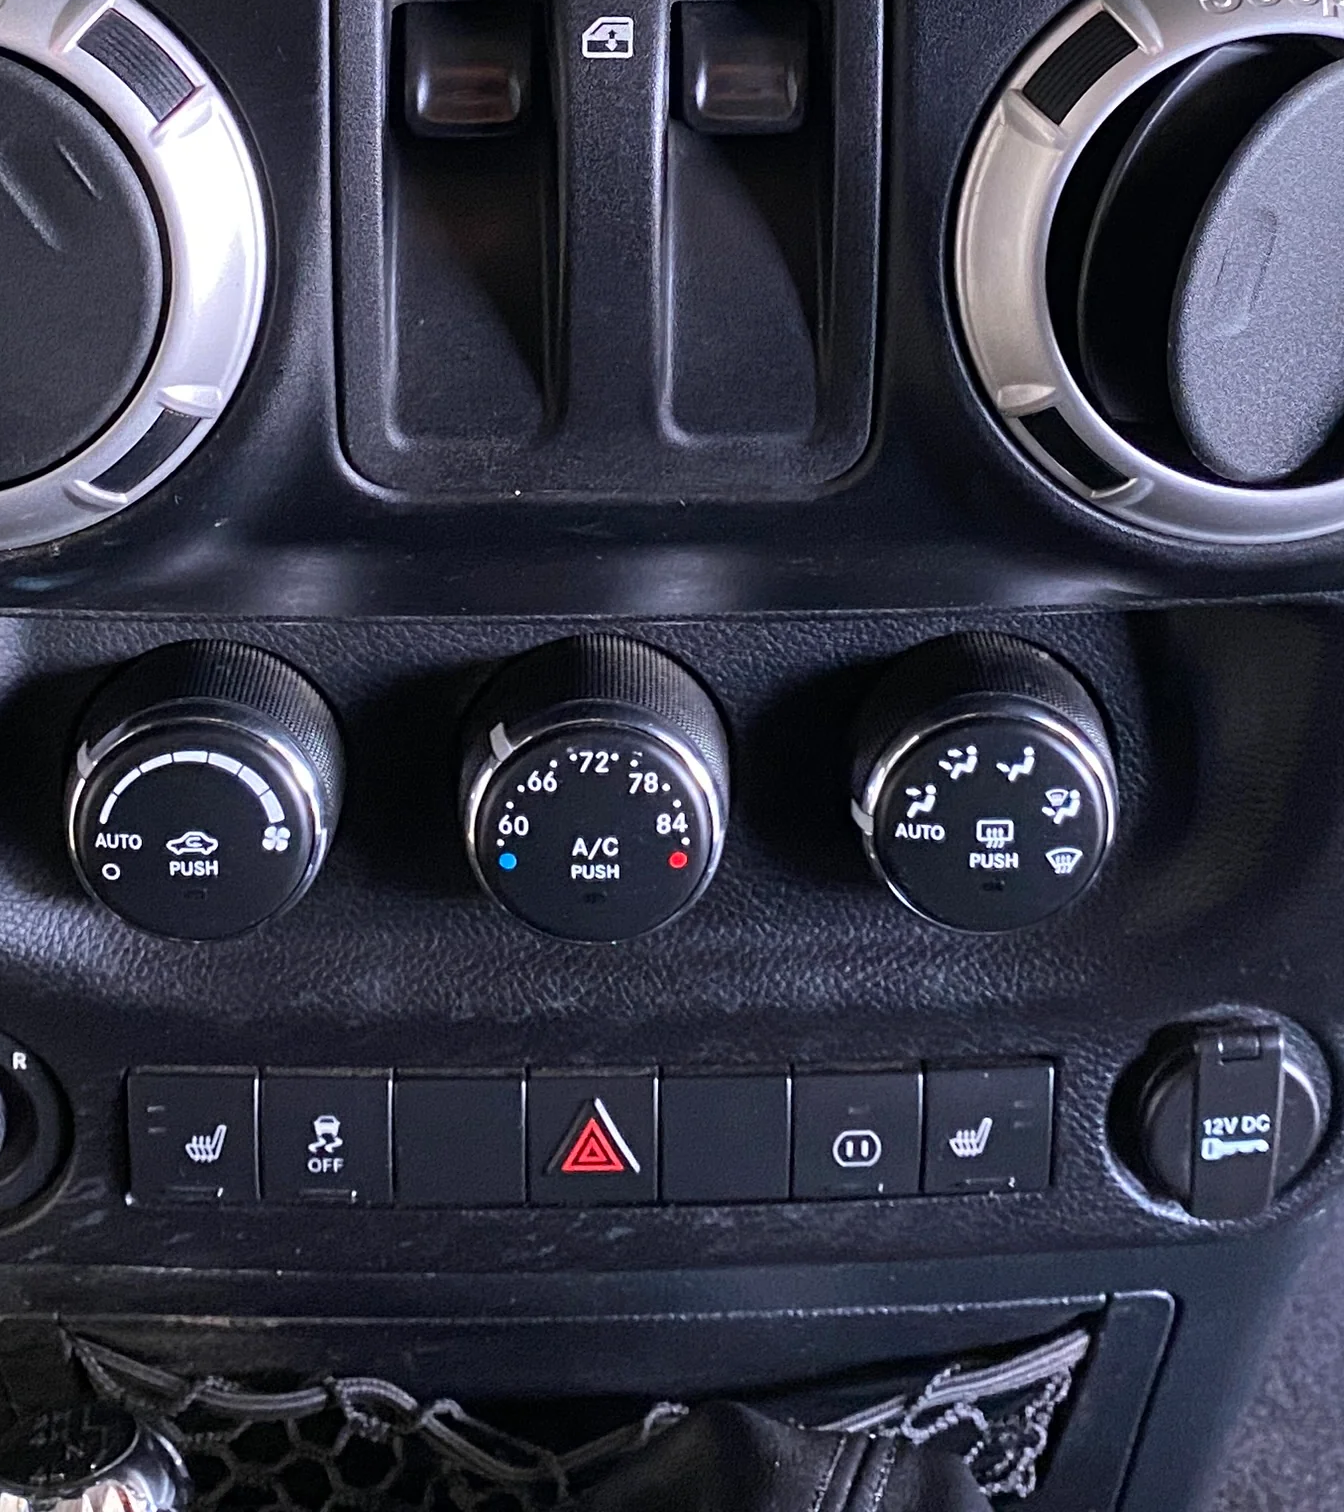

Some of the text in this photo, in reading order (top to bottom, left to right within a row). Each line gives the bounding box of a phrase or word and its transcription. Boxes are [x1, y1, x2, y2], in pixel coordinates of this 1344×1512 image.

[578, 749, 610, 775] 72
[526, 769, 558, 794] 66
[627, 771, 659, 796] 78
[497, 813, 530, 837] 60
[655, 811, 690, 836] 84
[893, 821, 946, 842] AUTO
[94, 832, 144, 852] AUTO
[570, 835, 620, 861] A/C
[168, 859, 220, 878] PUSH
[569, 862, 621, 881] PUSH
[968, 851, 1020, 870] PUSH
[11, 1050, 28, 1071] R
[1202, 1113, 1272, 1137] 12V DC
[307, 1156, 345, 1174] OFF
